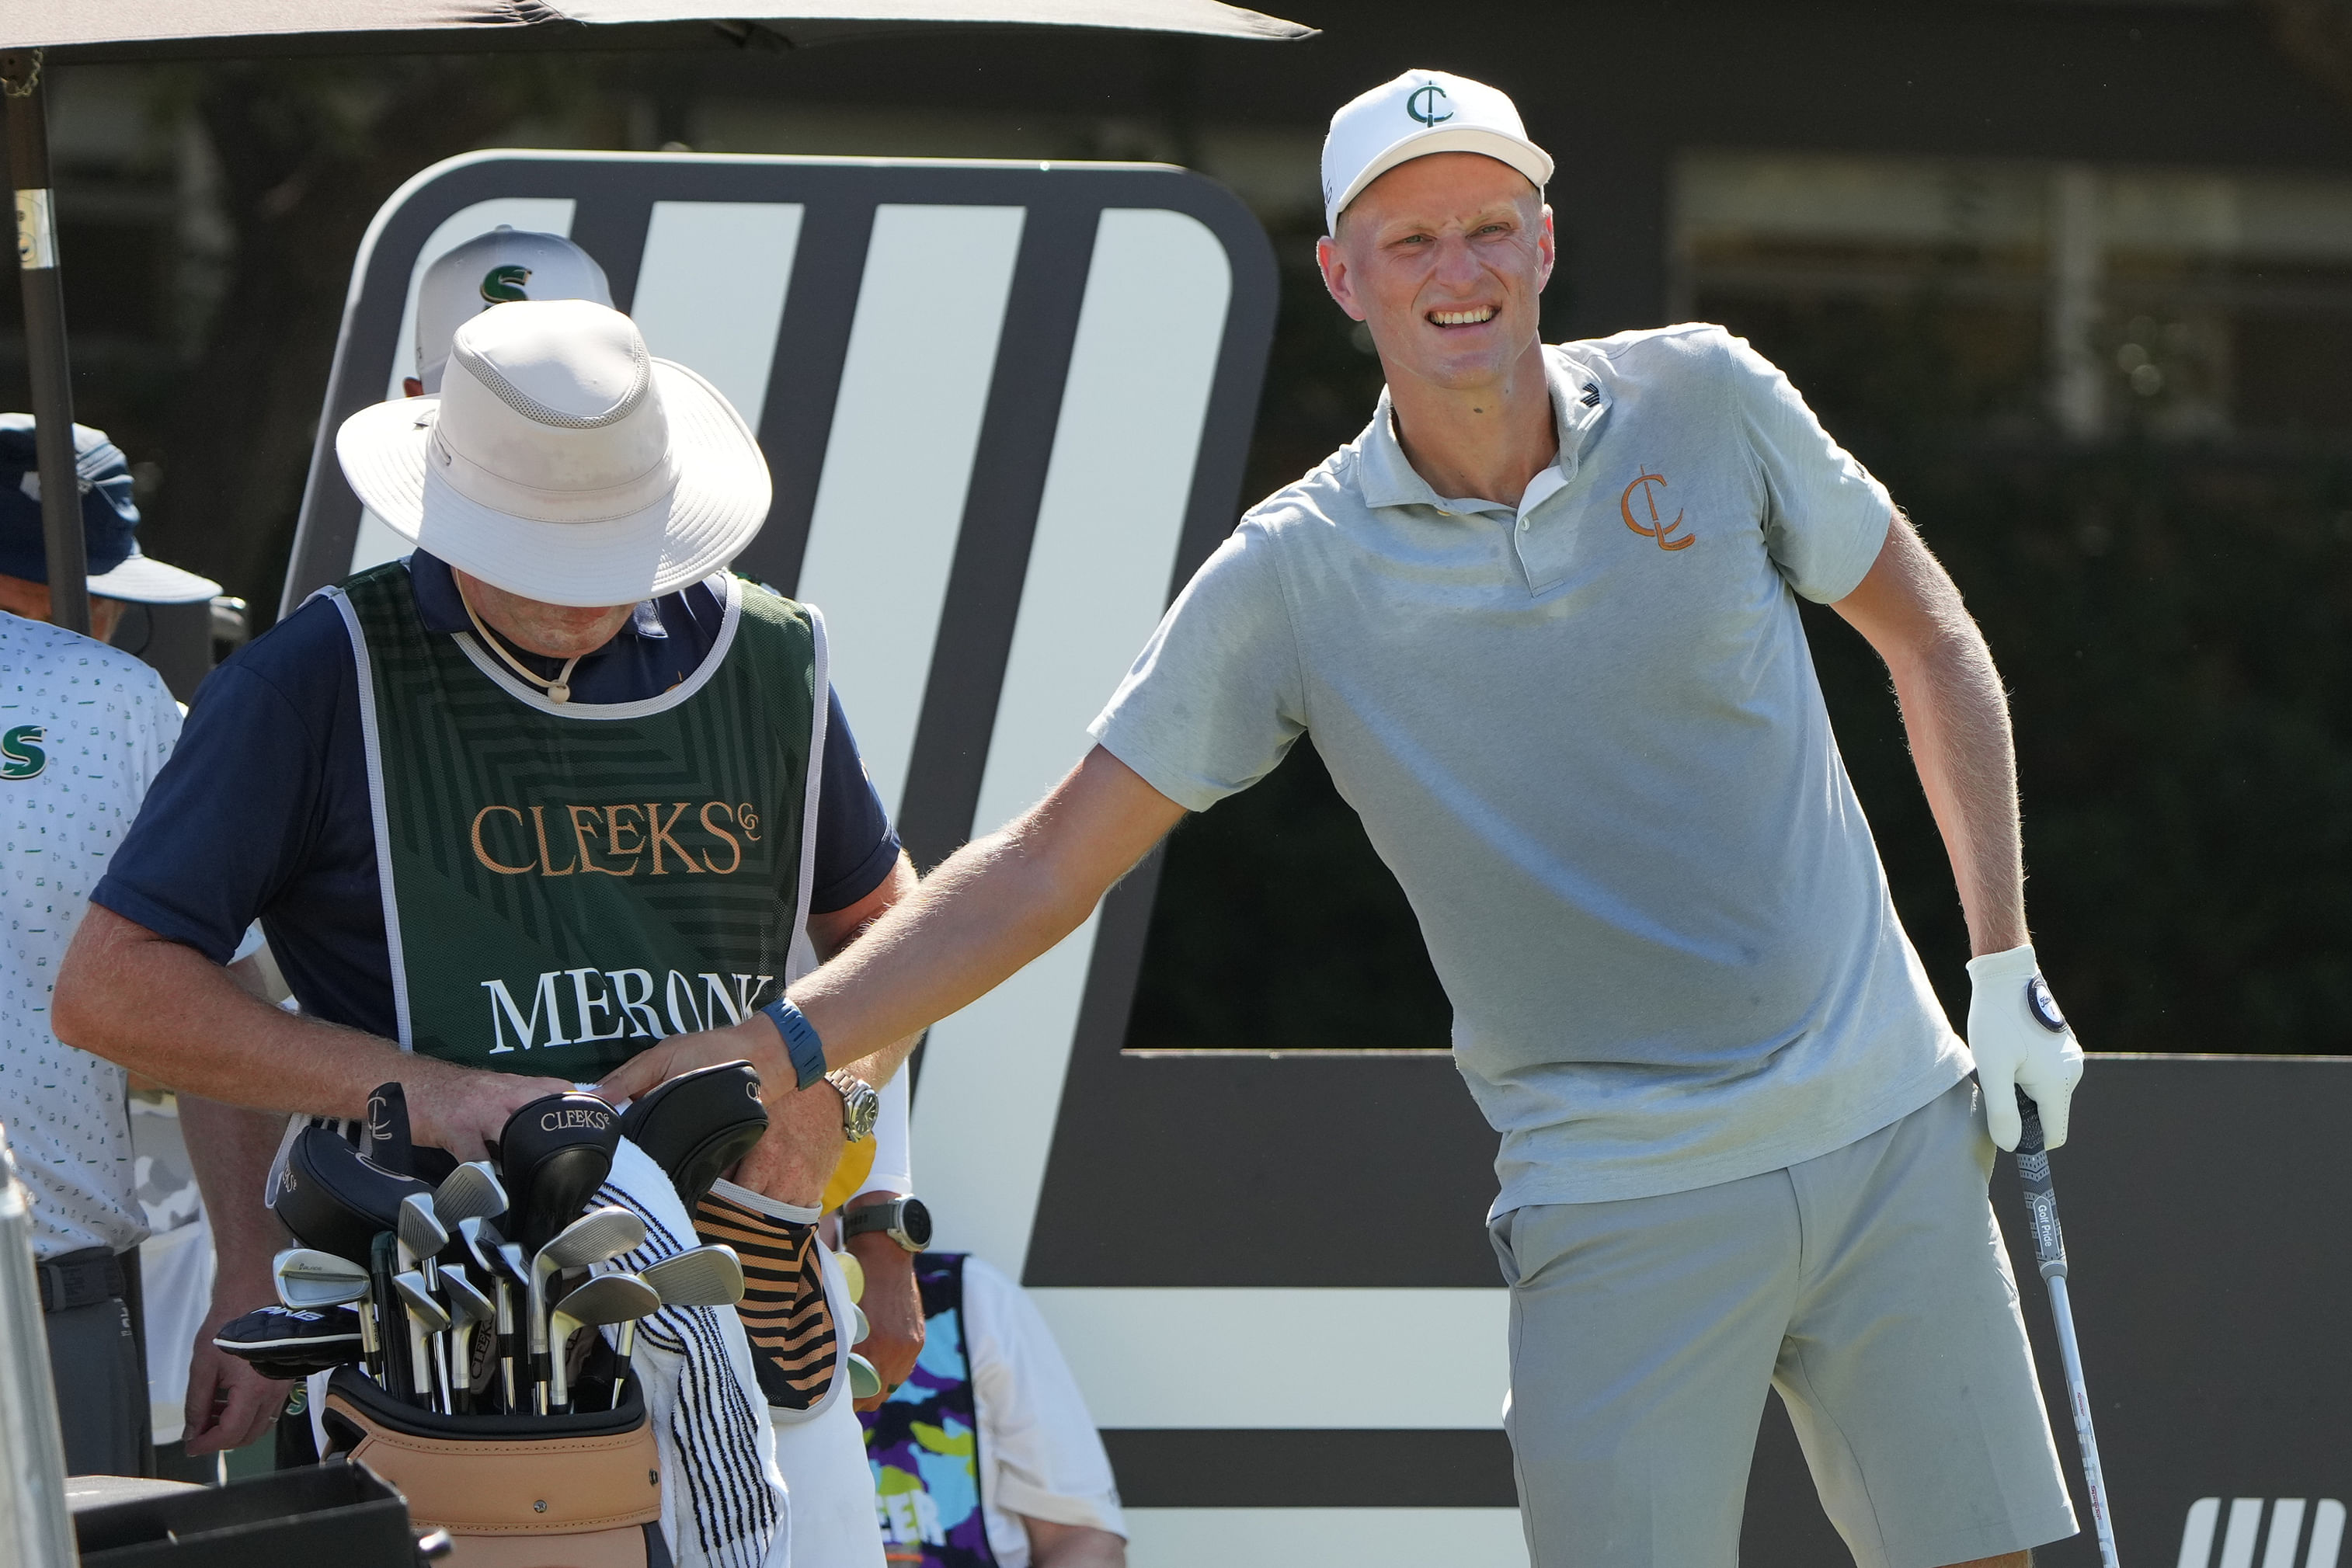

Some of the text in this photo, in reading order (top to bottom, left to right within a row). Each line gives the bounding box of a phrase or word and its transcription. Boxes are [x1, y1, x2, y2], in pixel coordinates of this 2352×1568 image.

[0, 725, 47, 781] S
[471, 801, 741, 876] CLEEKS
[541, 1109, 606, 1132] CLEEKS
[2037, 1205, 2053, 1247] Golf Pride
